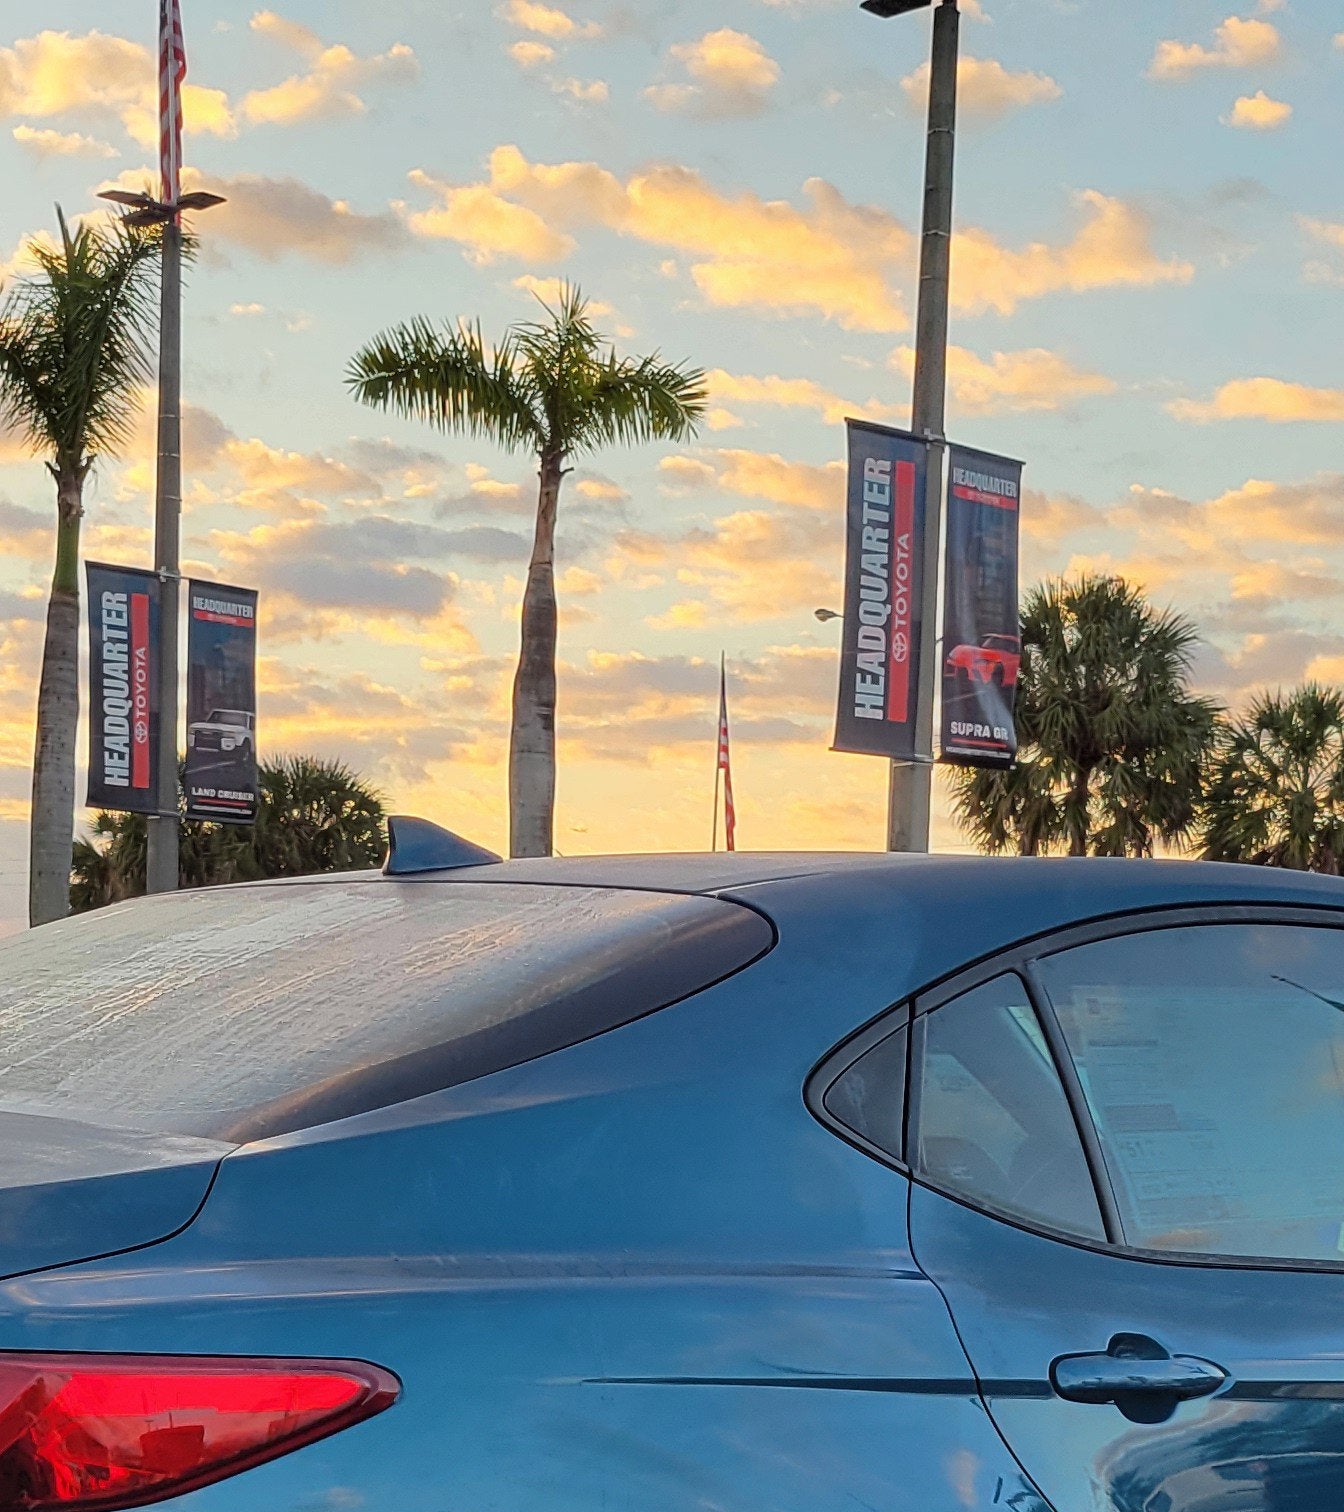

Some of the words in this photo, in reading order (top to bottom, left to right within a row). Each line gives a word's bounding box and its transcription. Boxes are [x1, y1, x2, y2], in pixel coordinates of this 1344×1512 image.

[854, 456, 892, 721] HEADQUARTER
[894, 533, 910, 629] TOYOTA
[101, 591, 133, 787] HEADQUARTER
[136, 647, 147, 718] TOYOTA
[950, 721, 992, 738] SUPRA
[993, 726, 1009, 741] GR
[191, 786, 216, 798] LAND
